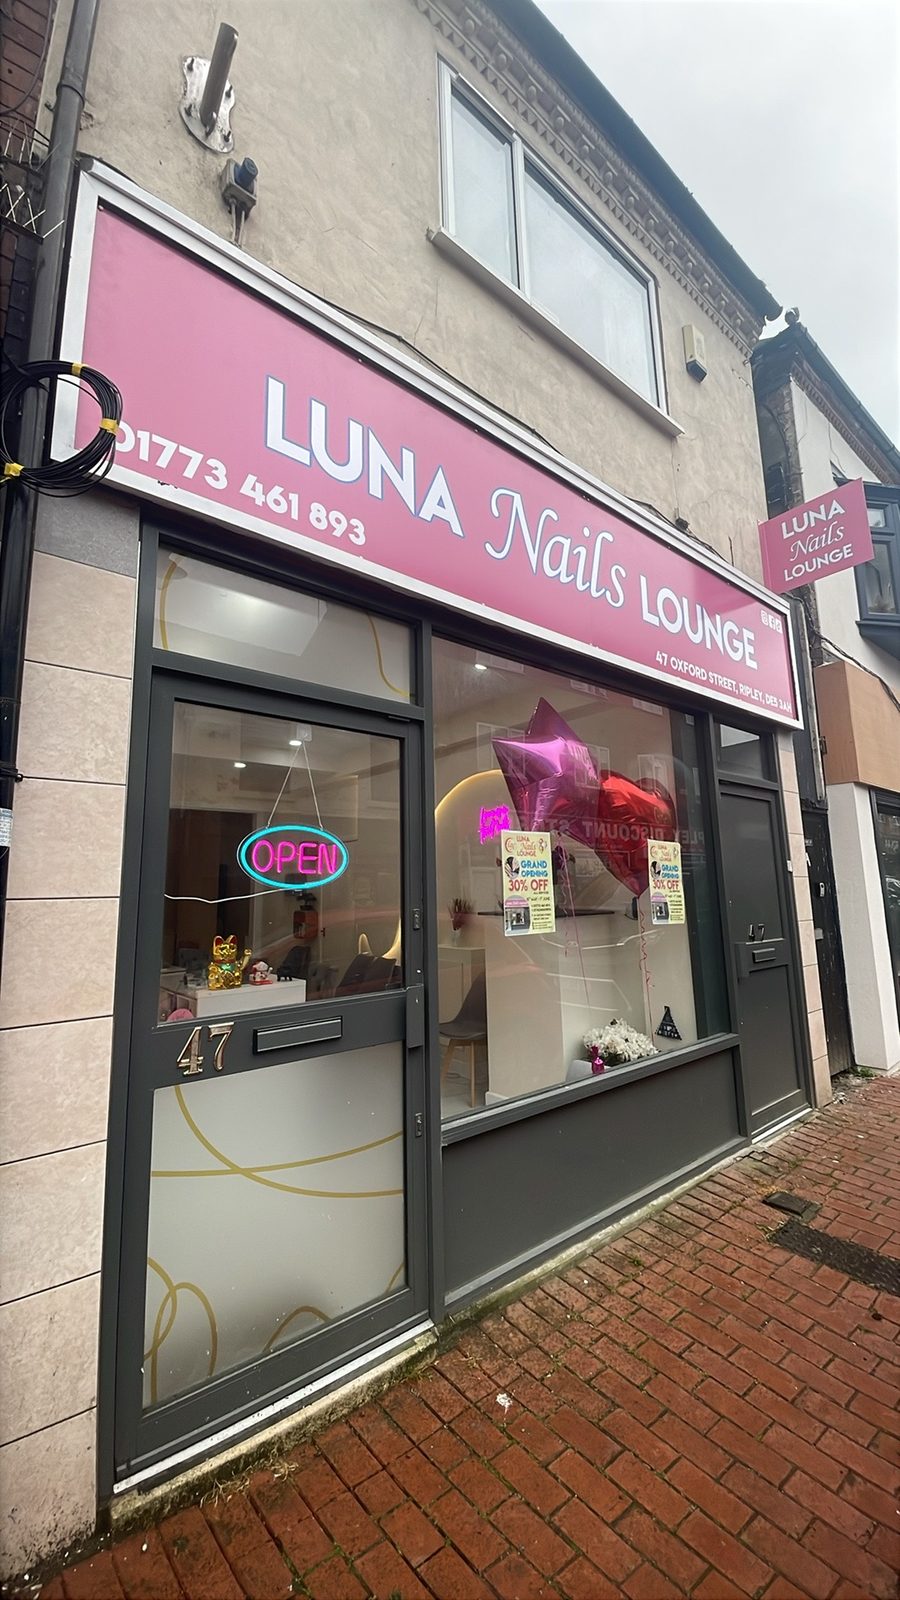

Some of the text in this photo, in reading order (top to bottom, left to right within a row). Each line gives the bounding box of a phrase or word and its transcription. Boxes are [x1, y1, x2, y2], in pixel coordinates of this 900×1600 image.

[239, 474, 299, 520] 461
[308, 502, 366, 546] 893
[266, 375, 758, 670] LUNA Nails LOUNGE
[781, 500, 845, 539] LUNA
[789, 521, 845, 561] Nails
[784, 544, 854, 581] LOUNGE
[656, 651, 668, 666] 47
[670, 656, 707, 681] OXFORD
[708, 672, 739, 695] STREET,
[739, 683, 766, 705] RIPLEY,
[252, 839, 337, 875] OPEN
[521, 860, 548, 869] GRAND
[521, 869, 549, 878] OPENING
[508, 879, 549, 892] 30% OFF
[653, 879, 680, 890] 30% OFF
[176, 1021, 235, 1076] 47
